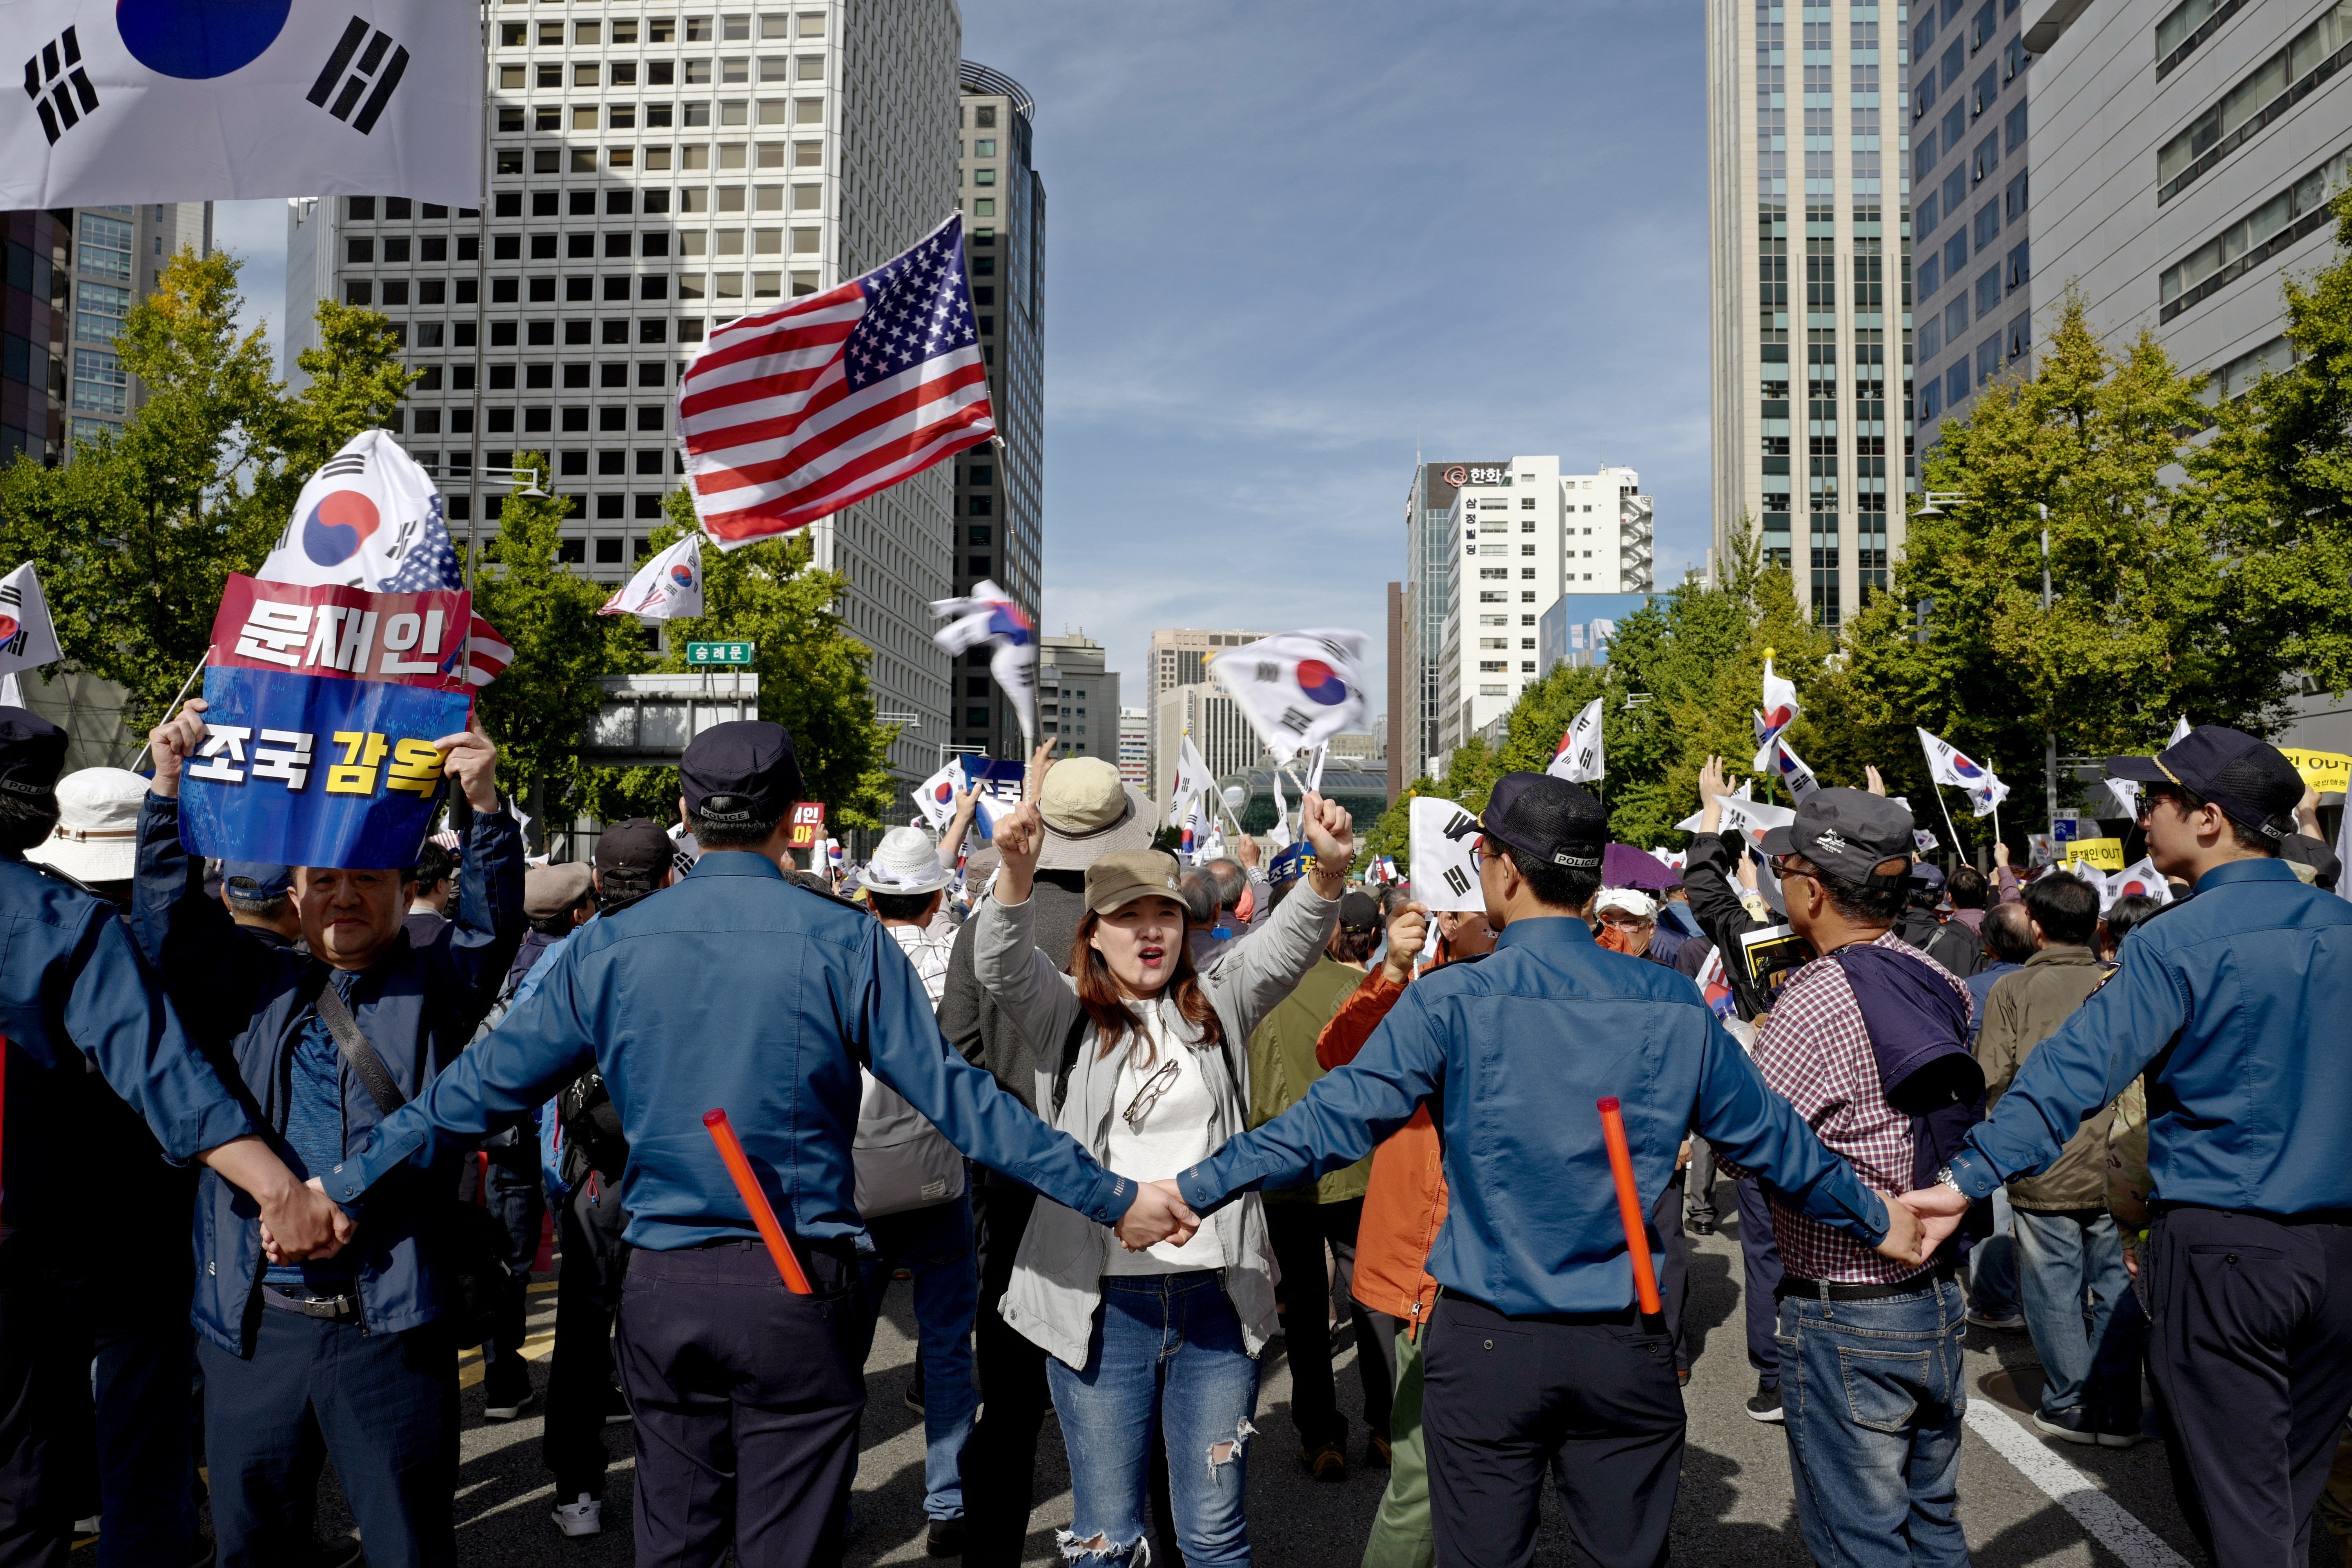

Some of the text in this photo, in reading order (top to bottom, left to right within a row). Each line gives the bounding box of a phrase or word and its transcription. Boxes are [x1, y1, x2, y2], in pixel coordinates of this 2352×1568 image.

[1470, 468, 1501, 484] 한화
[1465, 498, 1477, 555] 삼정빌딩
[234, 599, 443, 674] 문재인
[695, 646, 742, 660] 숭례문
[189, 724, 450, 798] 조국 감옥
[2309, 757, 2352, 771] OUT
[2313, 779, 2347, 788] 국민행동
[703, 809, 746, 820] POLICE
[2265, 827, 2283, 839] POL
[1558, 855, 1597, 866] POLICE
[2070, 848, 2120, 863] 문재인 OUT
[1269, 855, 1316, 885] 조국 감
[354, 1049, 390, 1097] airwalk
